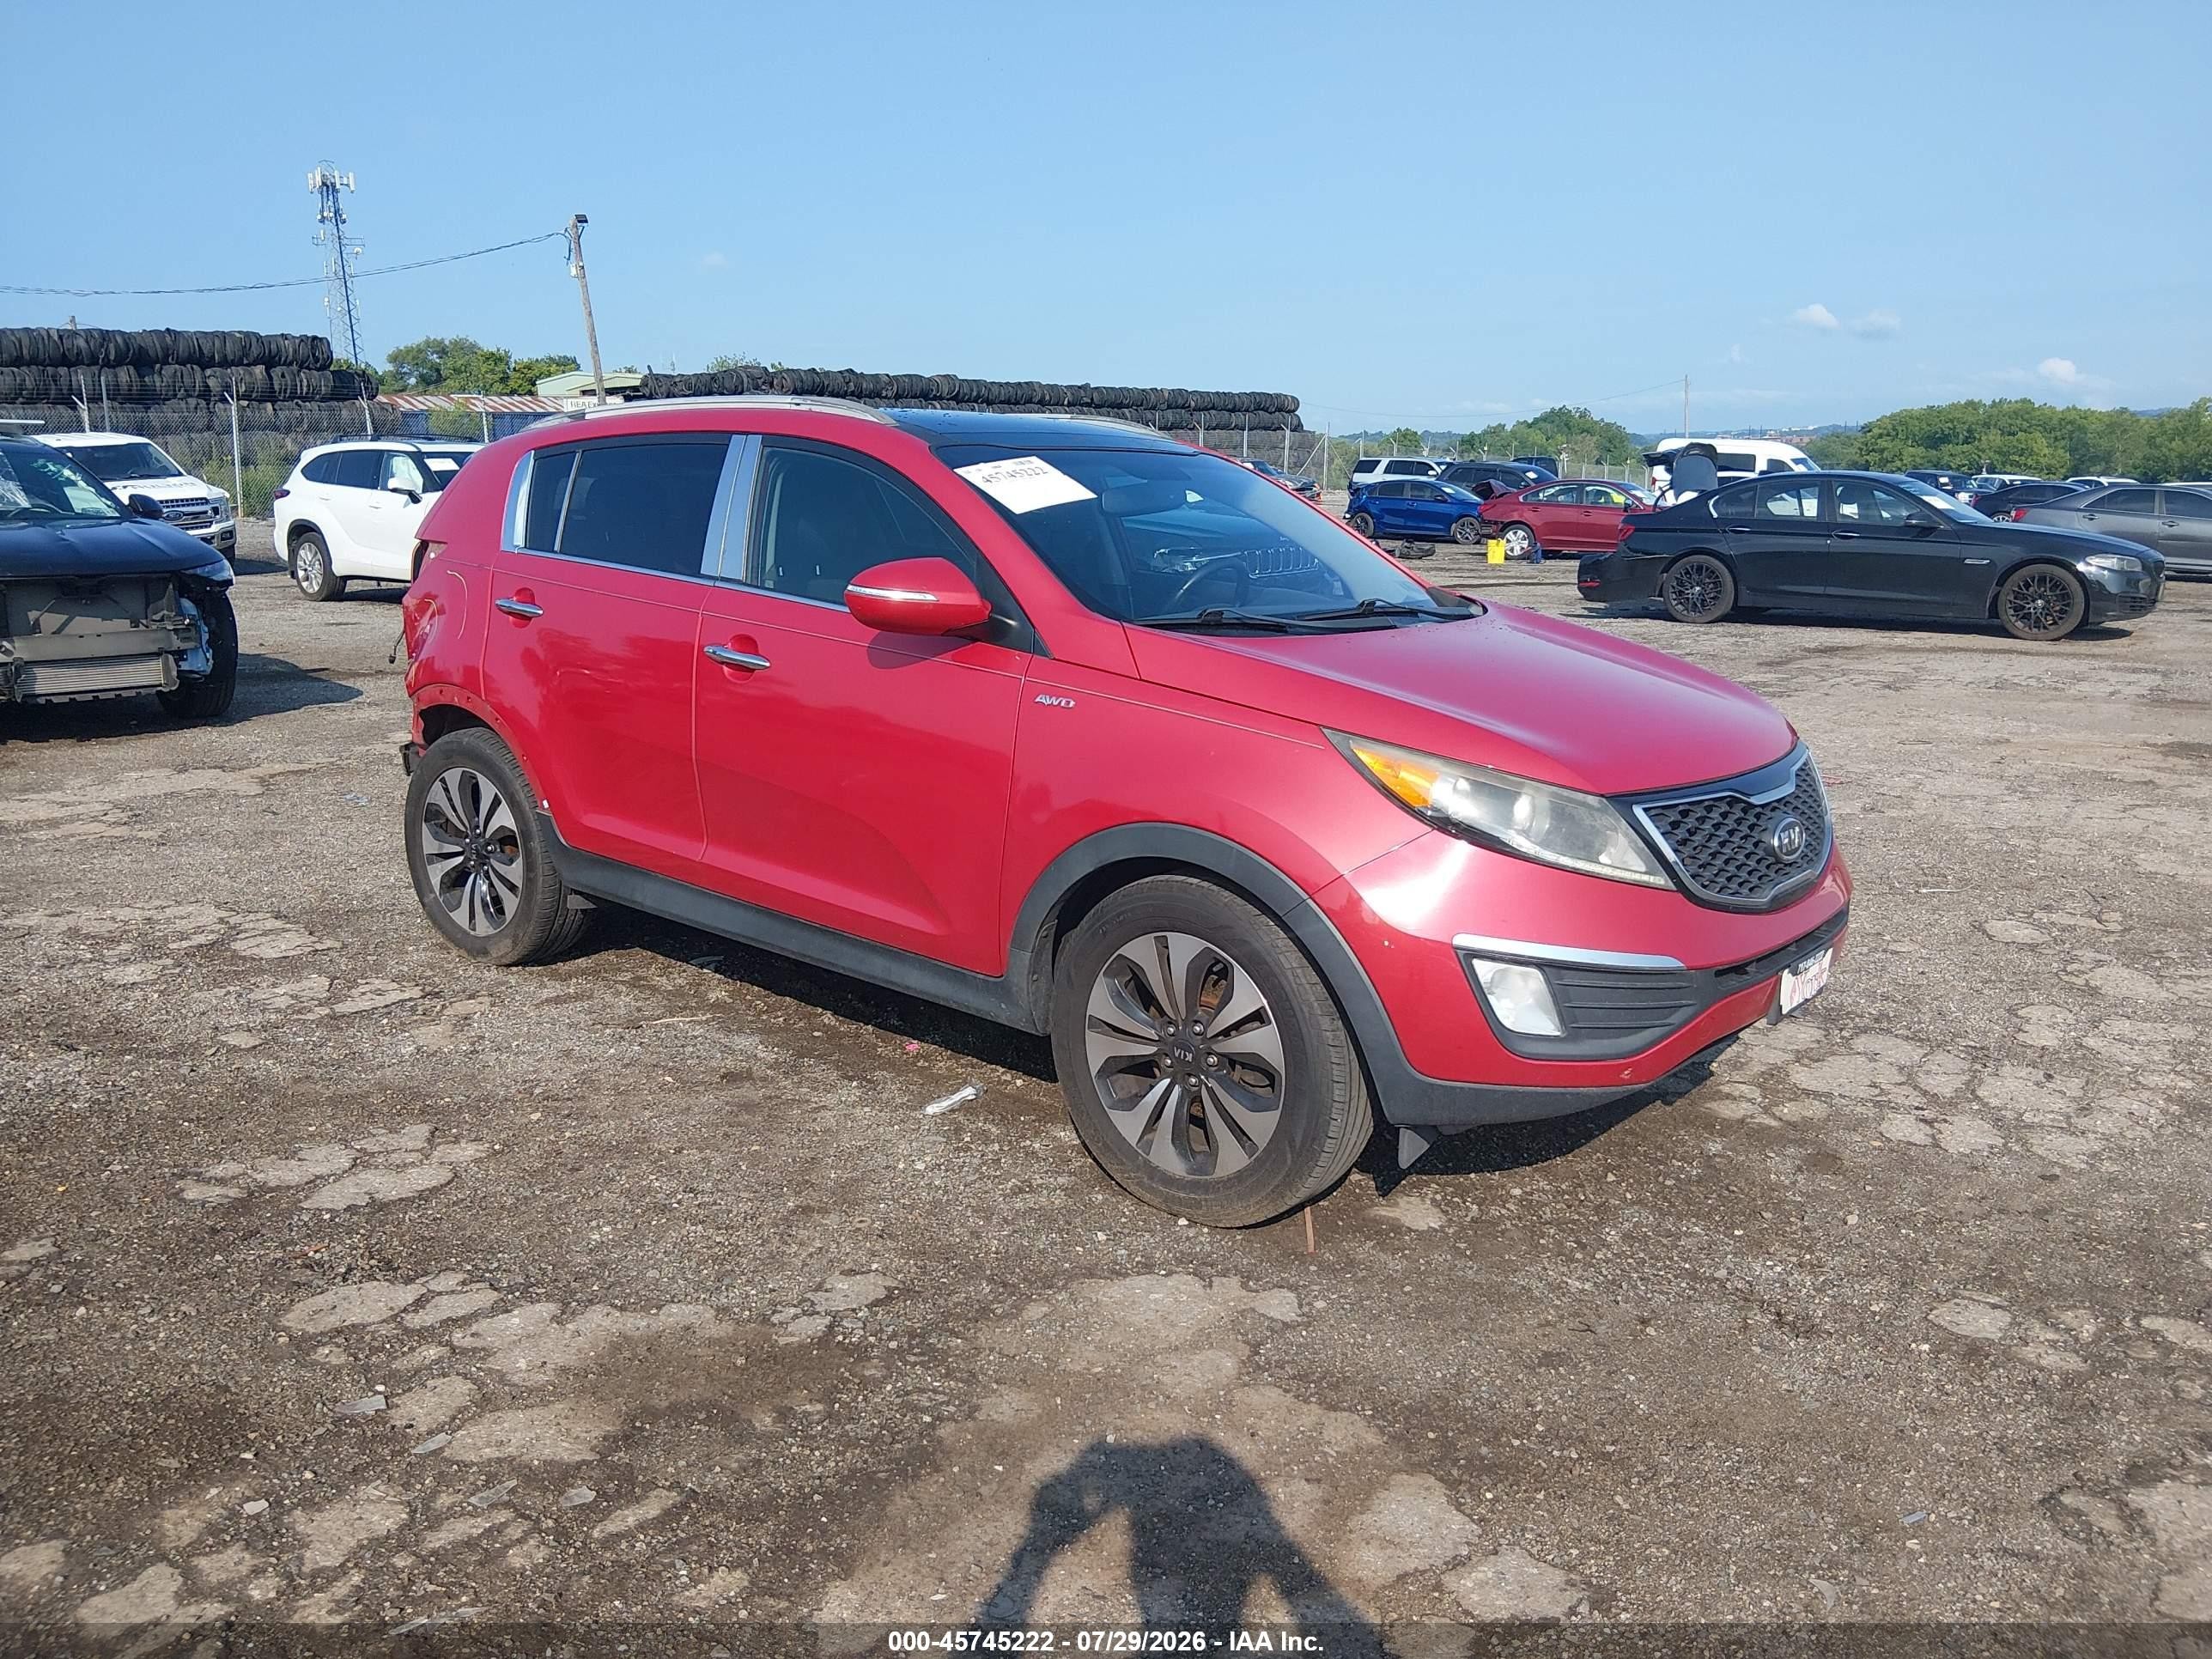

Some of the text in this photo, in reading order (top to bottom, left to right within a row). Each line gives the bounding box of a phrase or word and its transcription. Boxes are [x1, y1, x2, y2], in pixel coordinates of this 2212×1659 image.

[981, 466, 1049, 485] 45745222
[1034, 694, 1076, 708] AWD
[1779, 825, 1802, 854] KIA
[1173, 1046, 1194, 1063] KIA
